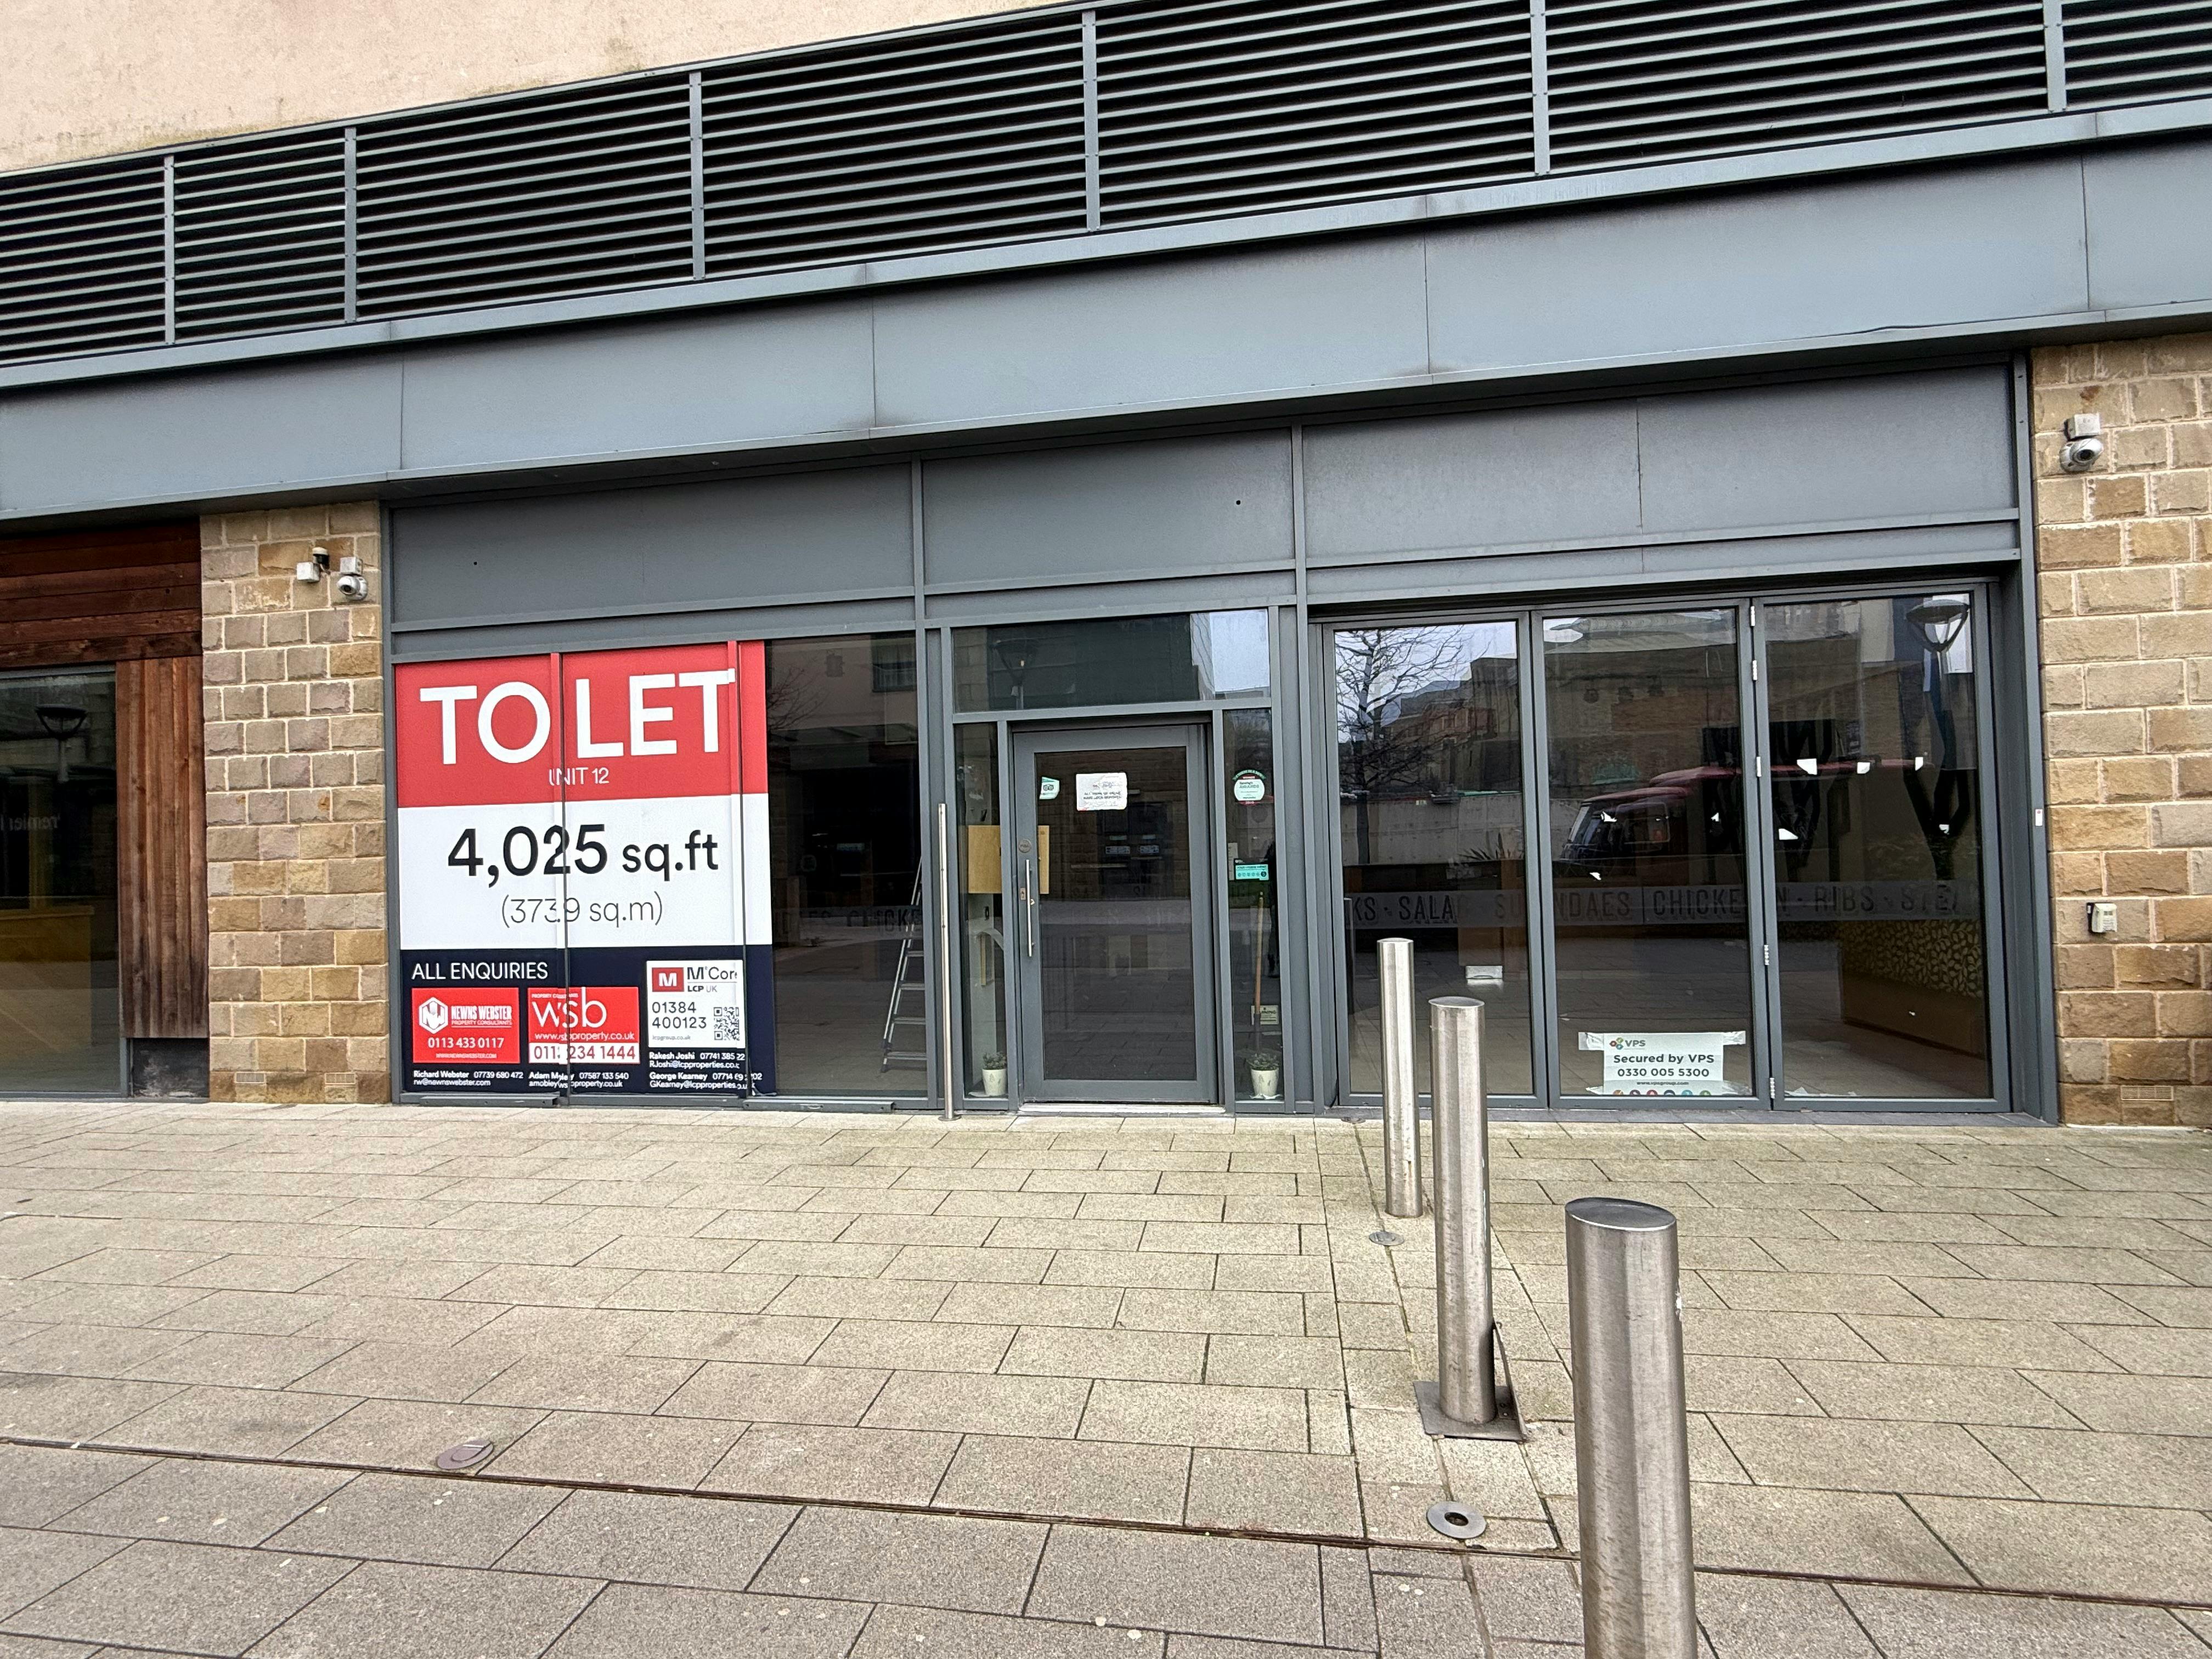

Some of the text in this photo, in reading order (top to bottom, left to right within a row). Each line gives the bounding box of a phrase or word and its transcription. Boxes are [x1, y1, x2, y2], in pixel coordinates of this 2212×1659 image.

[420, 668, 736, 765] TO LET
[549, 767, 610, 786] UNIT 12
[448, 823, 719, 888] 4,025 sq.ft
[589, 890, 663, 927] sq.m)
[1398, 894, 1462, 921] SALA
[411, 962, 548, 980] ALL ENQUIRIES
[658, 972, 677, 986] M
[451, 1005, 512, 1020] NEWNS WEBSTER
[532, 987, 607, 1028] wsb
[652, 1001, 696, 1014] 01384
[652, 1017, 707, 1029] 400123
[428, 1037, 505, 1048] 0113 433 0117
[534, 1046, 636, 1059] 011 234 1444
[649, 1052, 674, 1060] Rakesh
[675, 1052, 695, 1060] Joshi
[1613, 1054, 1714, 1064] Secured by VPS
[414, 1070, 439, 1079] Richard
[440, 1070, 470, 1079] Webster
[650, 1072, 676, 1081] George
[678, 1072, 708, 1081] Kearney
[1618, 1068, 1709, 1077] 0330 005 5300
